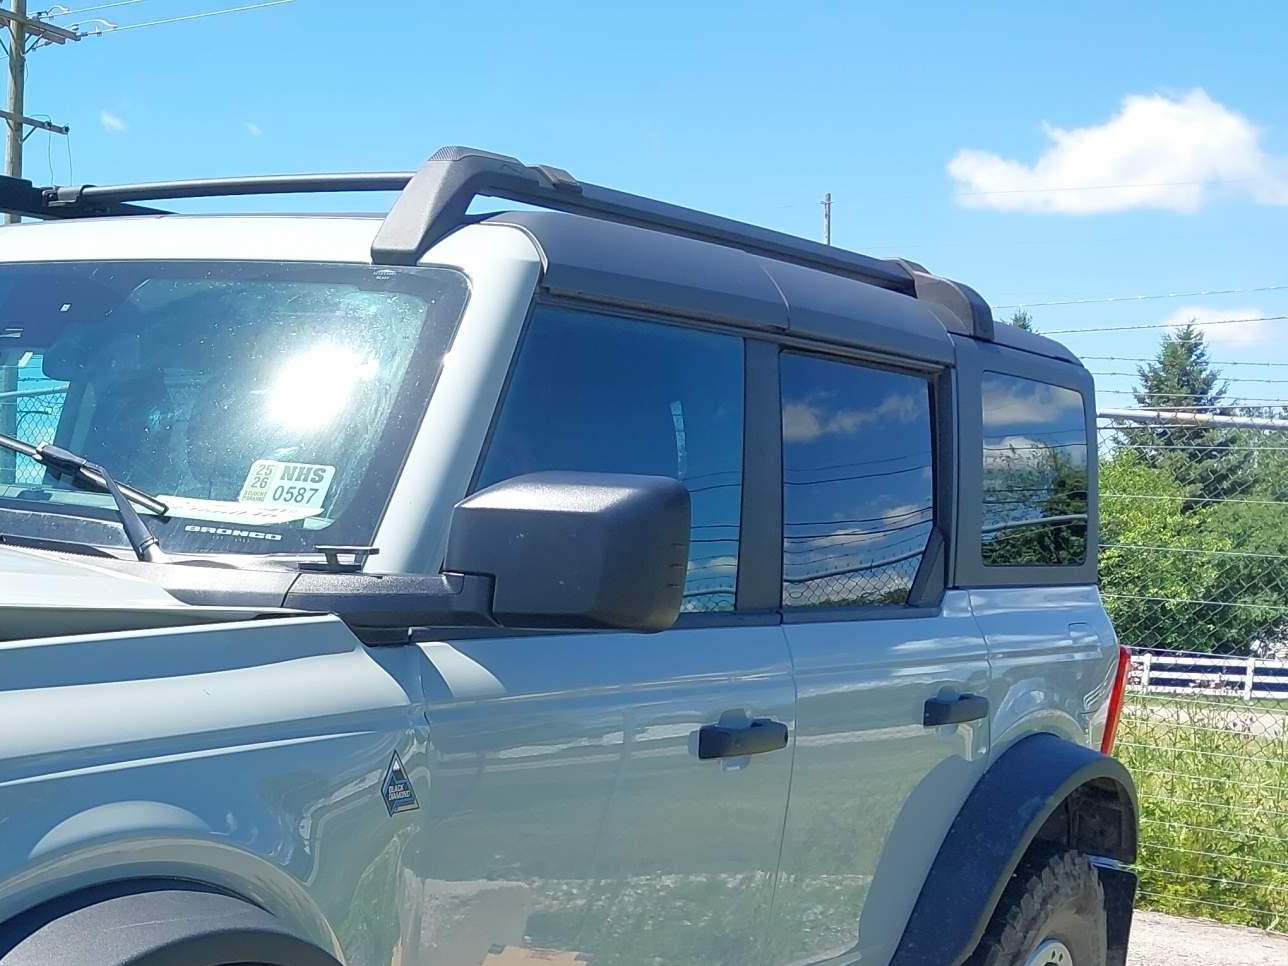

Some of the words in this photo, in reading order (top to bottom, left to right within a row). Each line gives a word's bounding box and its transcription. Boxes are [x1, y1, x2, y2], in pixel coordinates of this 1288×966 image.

[256, 464, 274, 476] 25
[279, 465, 326, 484] NHS
[250, 476, 270, 489] 26
[272, 485, 320, 505] 0587
[184, 525, 282, 541] BRONCO
[388, 784, 404, 793] BLACK
[388, 790, 411, 800] DIAMOND
